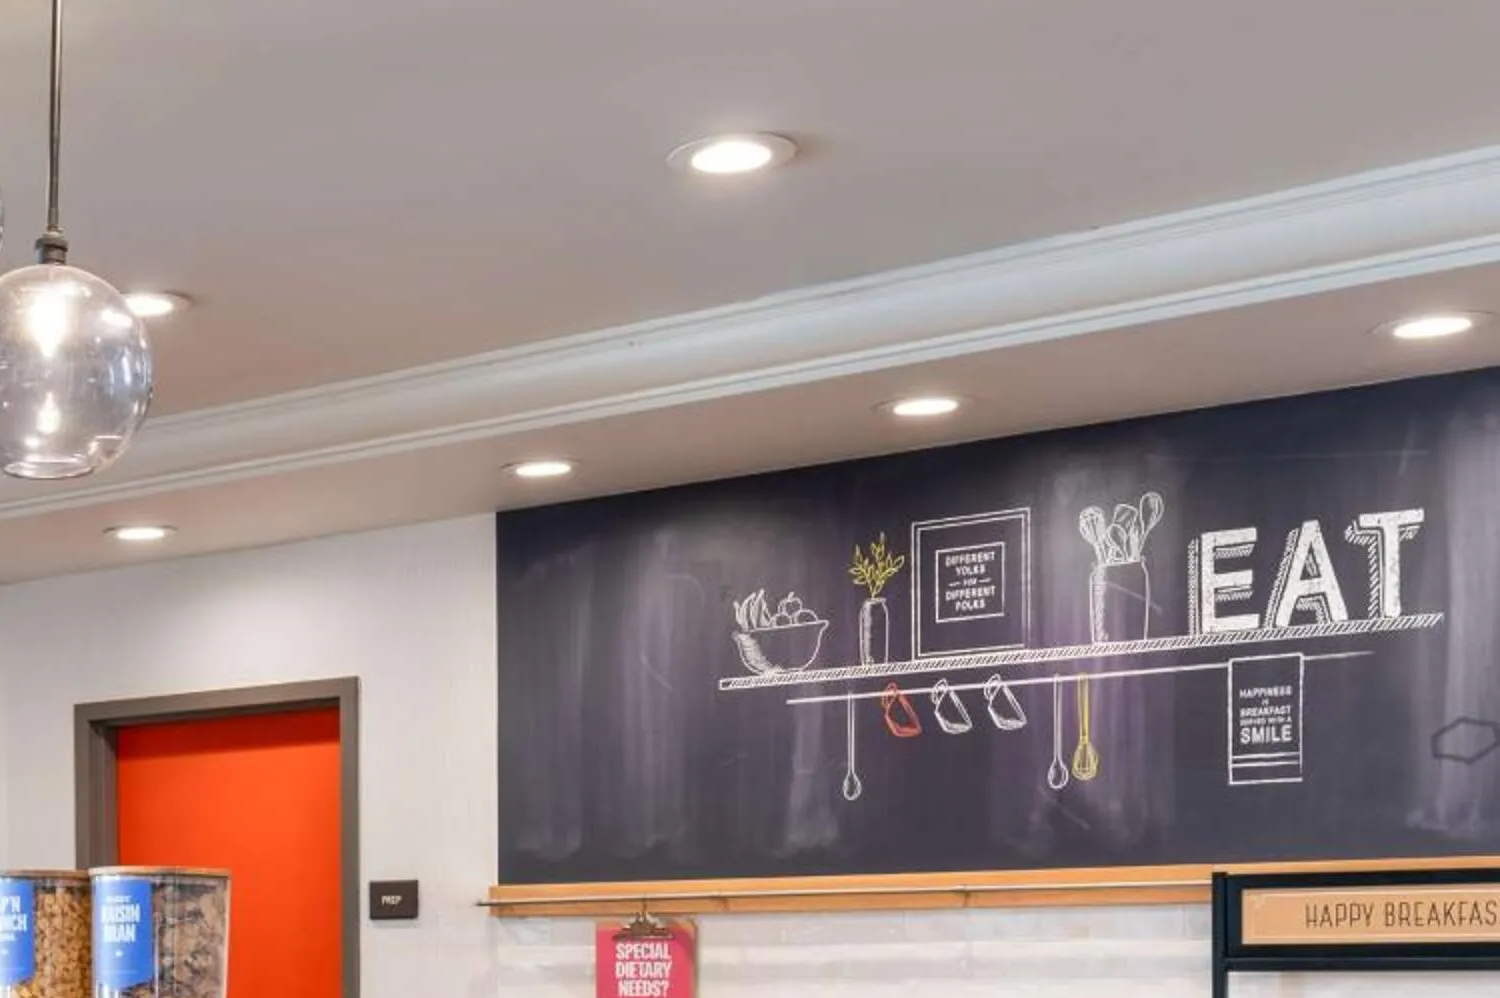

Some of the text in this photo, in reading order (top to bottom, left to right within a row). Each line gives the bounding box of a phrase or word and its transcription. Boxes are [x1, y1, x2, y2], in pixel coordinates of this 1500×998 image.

[945, 551, 995, 567] DIFFERENT
[1189, 508, 1424, 633] EAT
[945, 585, 996, 601] DIFFERENT
[1240, 685, 1292, 698] HAPPINESS
[1240, 705, 1291, 717] BREAKFAST
[1240, 724, 1292, 744] SMILE
[100, 903, 140, 923] RAISIN
[1305, 900, 1500, 928] HAPPY BREAKFAS
[104, 923, 136, 943] BRAN
[616, 943, 672, 960] SPECIAL
[616, 960, 672, 979] DIETARY
[618, 980, 669, 998] NEEDS?
